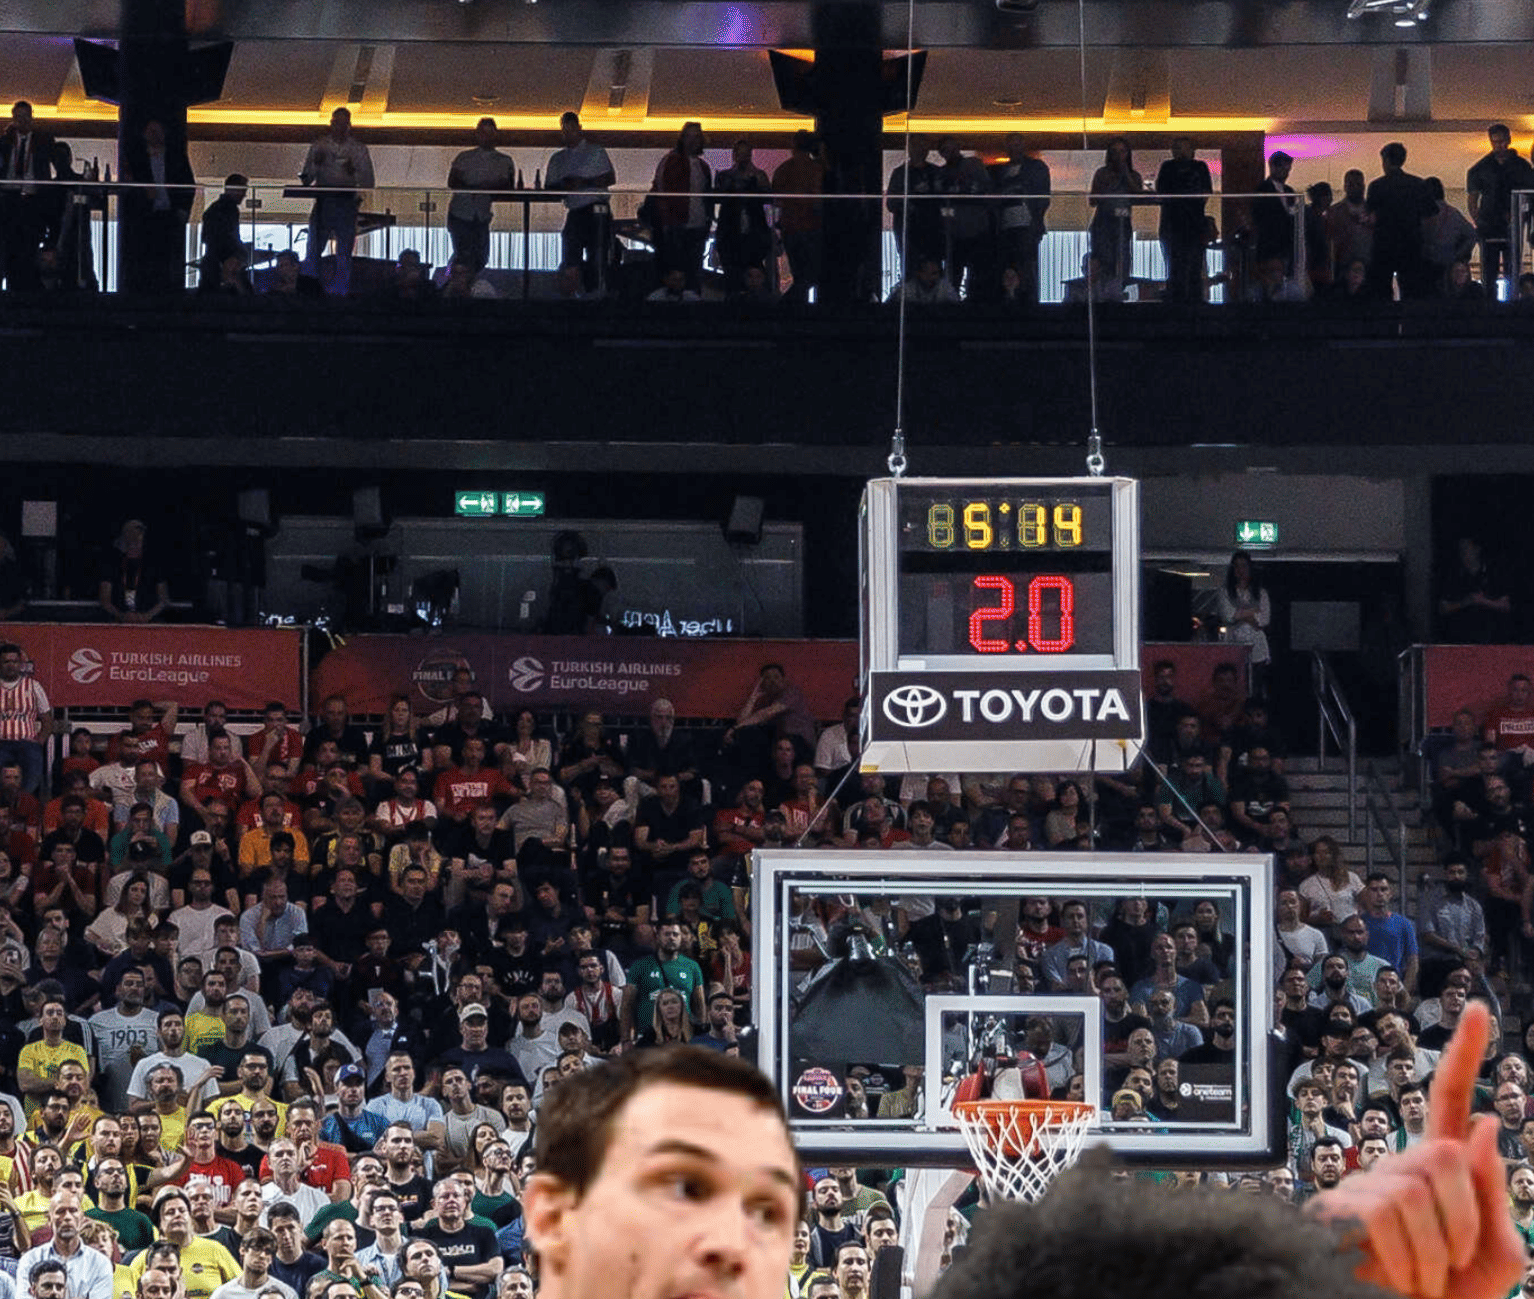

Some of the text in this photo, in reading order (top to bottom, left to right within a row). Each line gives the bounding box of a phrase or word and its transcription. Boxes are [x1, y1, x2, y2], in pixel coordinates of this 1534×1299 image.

[969, 575, 1074, 652] 2.0
[111, 652, 241, 667] TURKISH AIRLINES
[110, 666, 210, 685] EuroLeague
[551, 661, 682, 677] TURKISH AIRLINES
[551, 675, 650, 694] EuroLeague
[953, 688, 1131, 722] TOYOTA
[109, 1029, 147, 1047] 1903
[792, 1085, 843, 1096] FINAL FOUR
